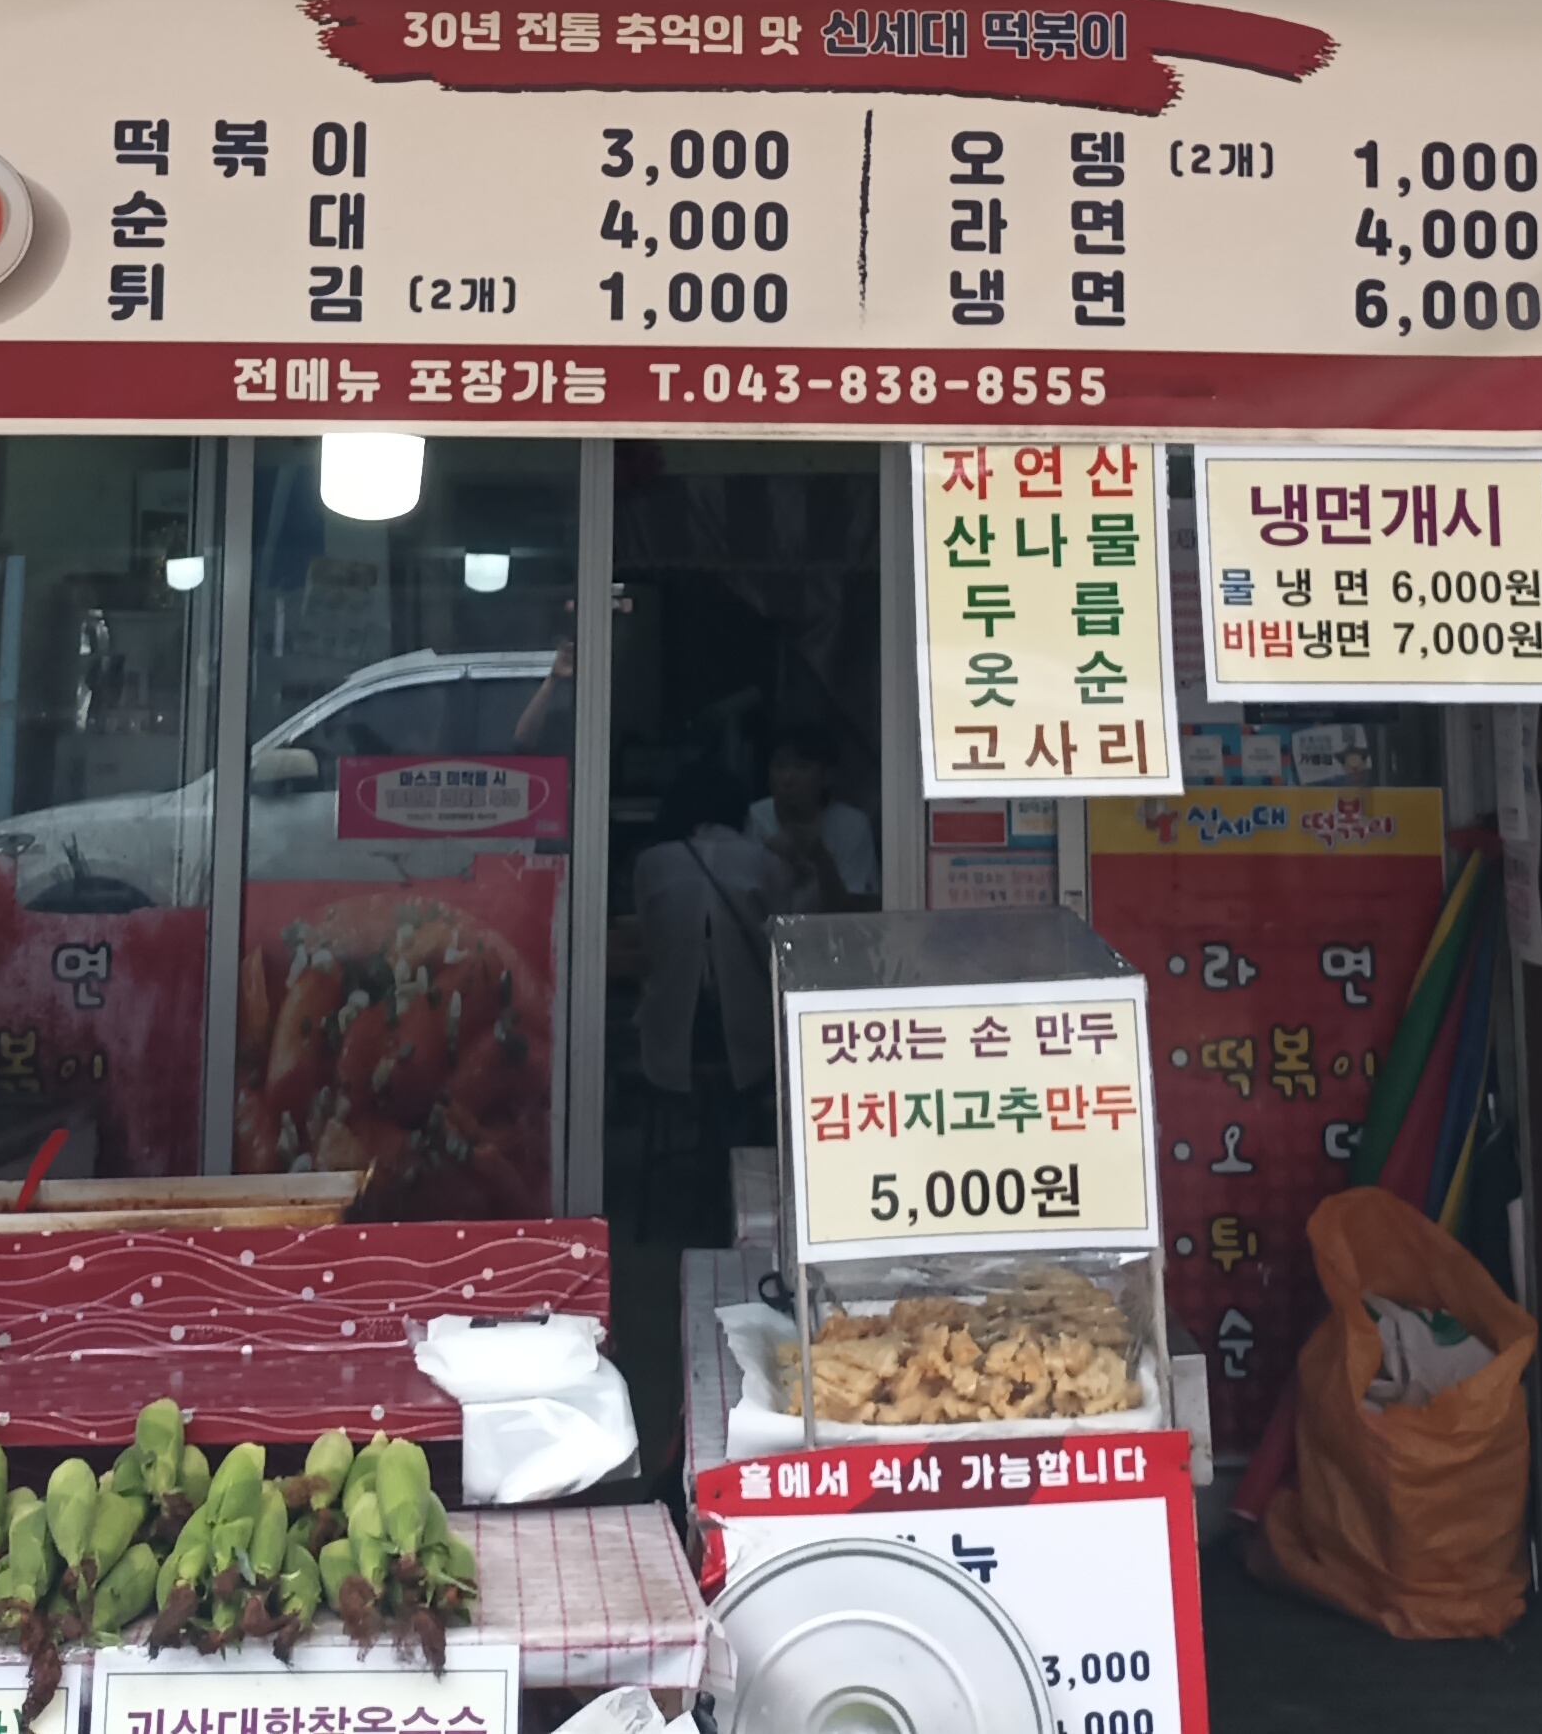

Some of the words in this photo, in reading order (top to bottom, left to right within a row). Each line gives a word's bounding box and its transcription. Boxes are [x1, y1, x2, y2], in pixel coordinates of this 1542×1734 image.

[404, 11, 500, 52] 30년
[517, 12, 601, 53] 전통
[615, 13, 744, 54] 추억의
[761, 15, 801, 56] 맛
[820, 9, 968, 59] 신세대
[983, 11, 1127, 61] 떡볶이
[600, 128, 790, 186] 3,000
[1170, 140, 1274, 178] (2개)
[1354, 140, 1538, 197] 1,000
[600, 199, 790, 257] 4,000
[1355, 207, 1539, 265] 4,000
[408, 275, 518, 314] (2개)
[599, 271, 790, 330] 1,000
[1355, 279, 1541, 337] 6,000
[234, 358, 381, 404] 전메뉴
[409, 359, 607, 406] 포장가능
[649, 362, 1107, 407] T.043-838-8555
[941, 443, 1138, 500] 자연산
[943, 513, 1141, 569] 산나물
[1250, 482, 1503, 547] 냉면개시
[1392, 567, 1542, 609] 6,000원
[1223, 620, 1371, 660] 비빔냉면
[952, 719, 1150, 775] 고사리
[1186, 804, 1288, 845] 신세대
[1299, 795, 1396, 852] 떡볶이
[821, 1018, 948, 1065] 맛있는
[970, 1015, 1011, 1059] 손
[1035, 1011, 1119, 1057] 만두
[810, 1085, 1139, 1141] 김치지고추만두
[870, 1162, 1082, 1228] 5,000원
[739, 1460, 850, 1499] 홀에서
[869, 1457, 942, 1495] 식사
[961, 1445, 1147, 1491] 가능합니다
[1042, 1650, 1150, 1692] 3,000
